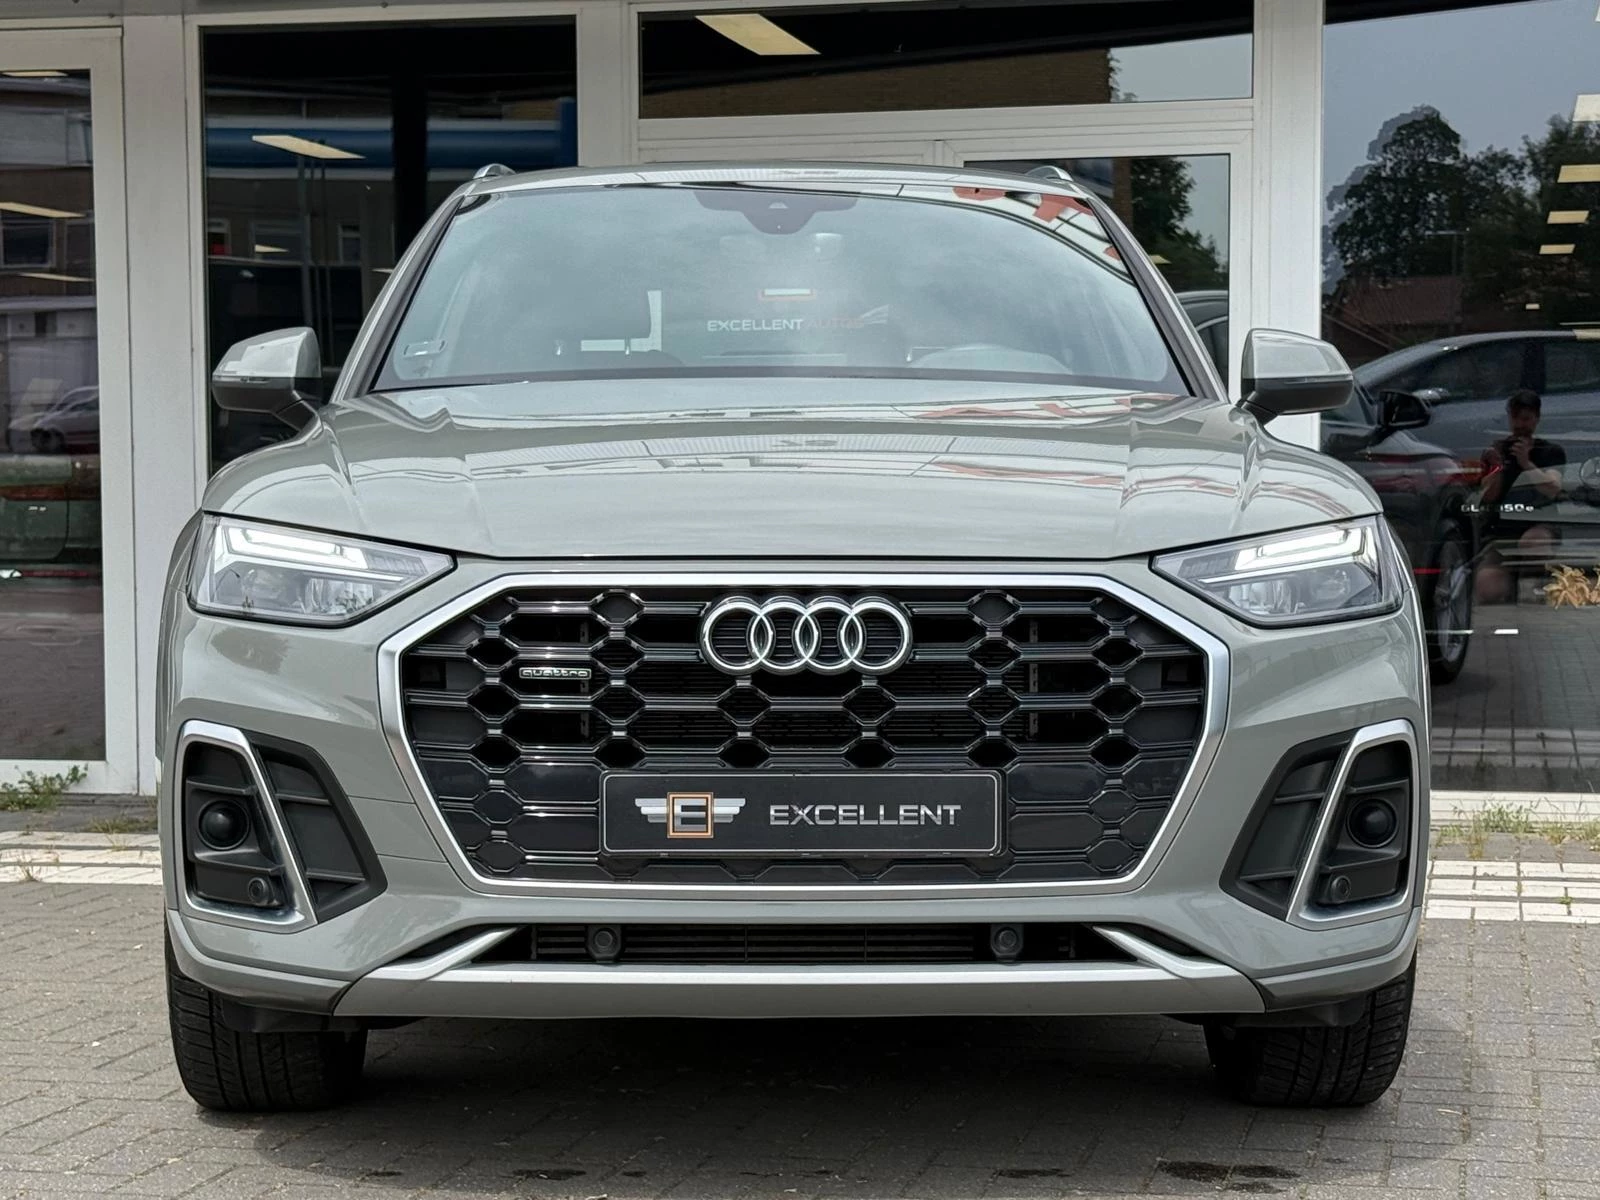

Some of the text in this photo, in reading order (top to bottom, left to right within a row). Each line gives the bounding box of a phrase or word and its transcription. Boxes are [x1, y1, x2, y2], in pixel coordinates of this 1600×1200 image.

[707, 318, 804, 332] EXCELLENT
[522, 668, 589, 678] quattro
[673, 798, 962, 830] E EXCELLENT
